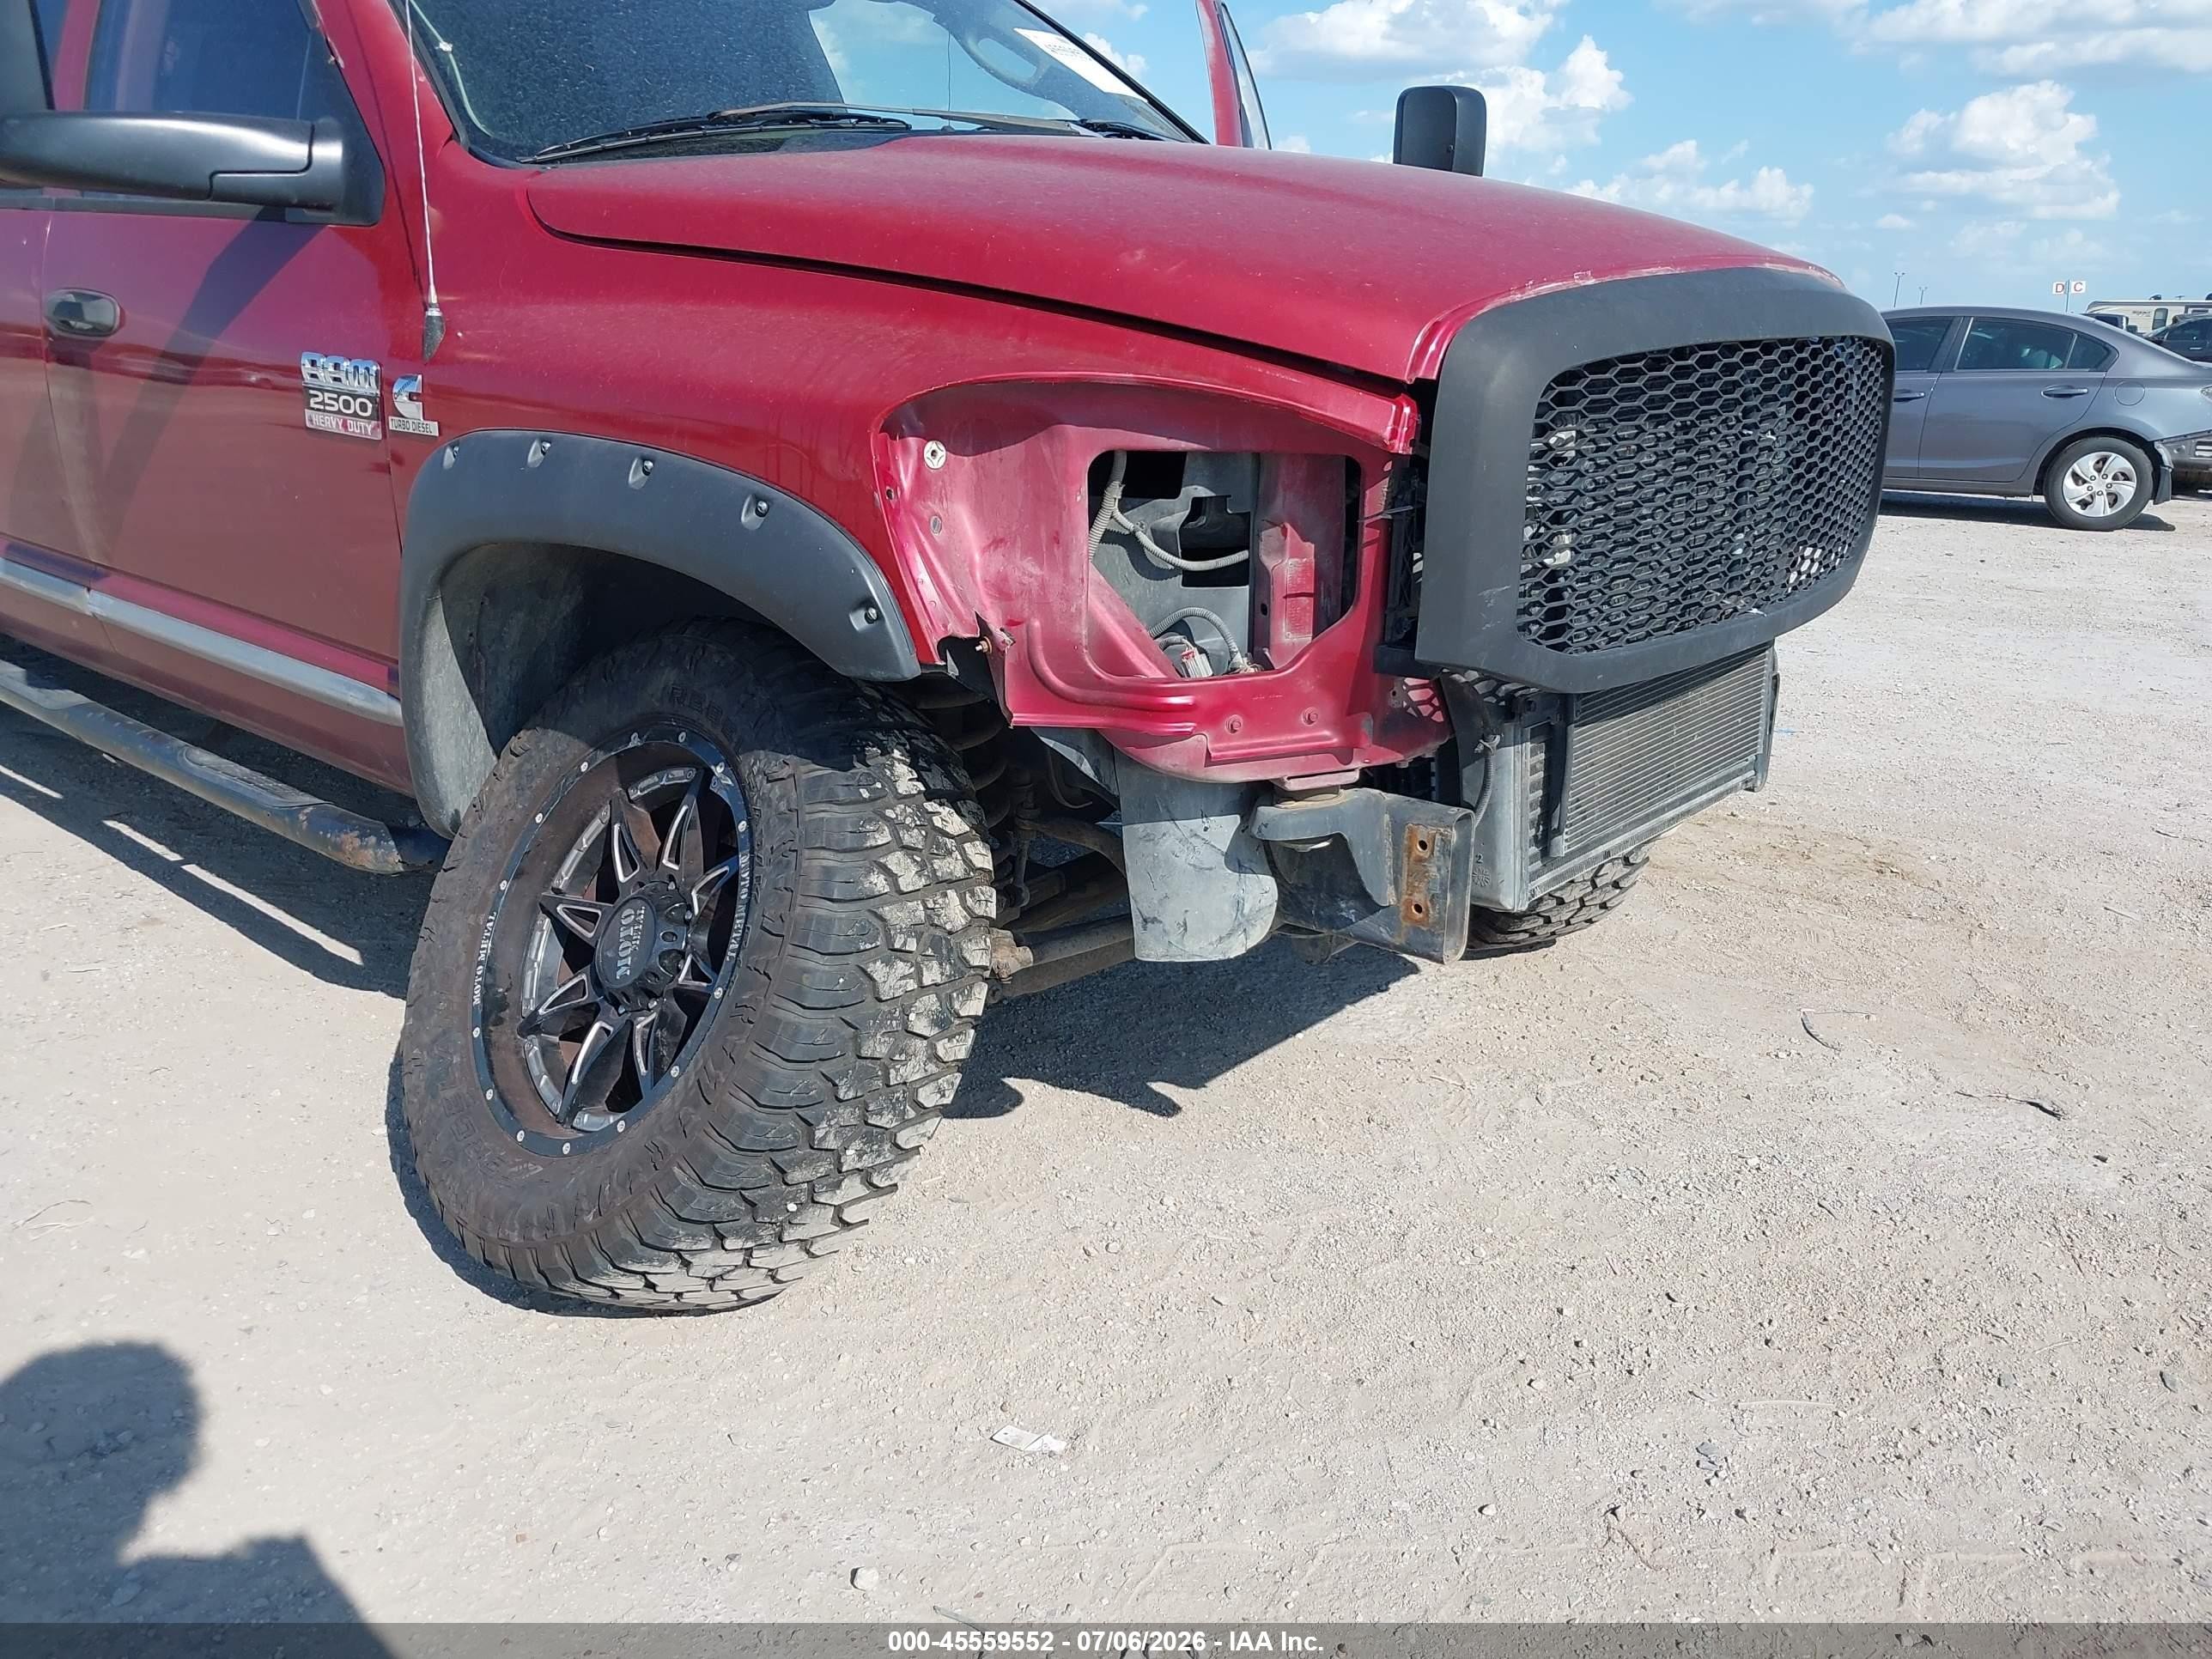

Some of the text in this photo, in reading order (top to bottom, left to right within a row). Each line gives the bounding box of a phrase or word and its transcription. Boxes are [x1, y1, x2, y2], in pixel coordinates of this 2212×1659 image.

[2055, 283, 2065, 294] D
[2073, 282, 2083, 293] C
[301, 351, 380, 390] RAM
[308, 390, 373, 417] 2500
[313, 414, 373, 435] HEAVY DUTY
[391, 417, 433, 434] TURBO DIESEL
[630, 906, 646, 951] METAL
[616, 908, 635, 980] MOTO
[472, 910, 497, 1006] MOTO METAL
